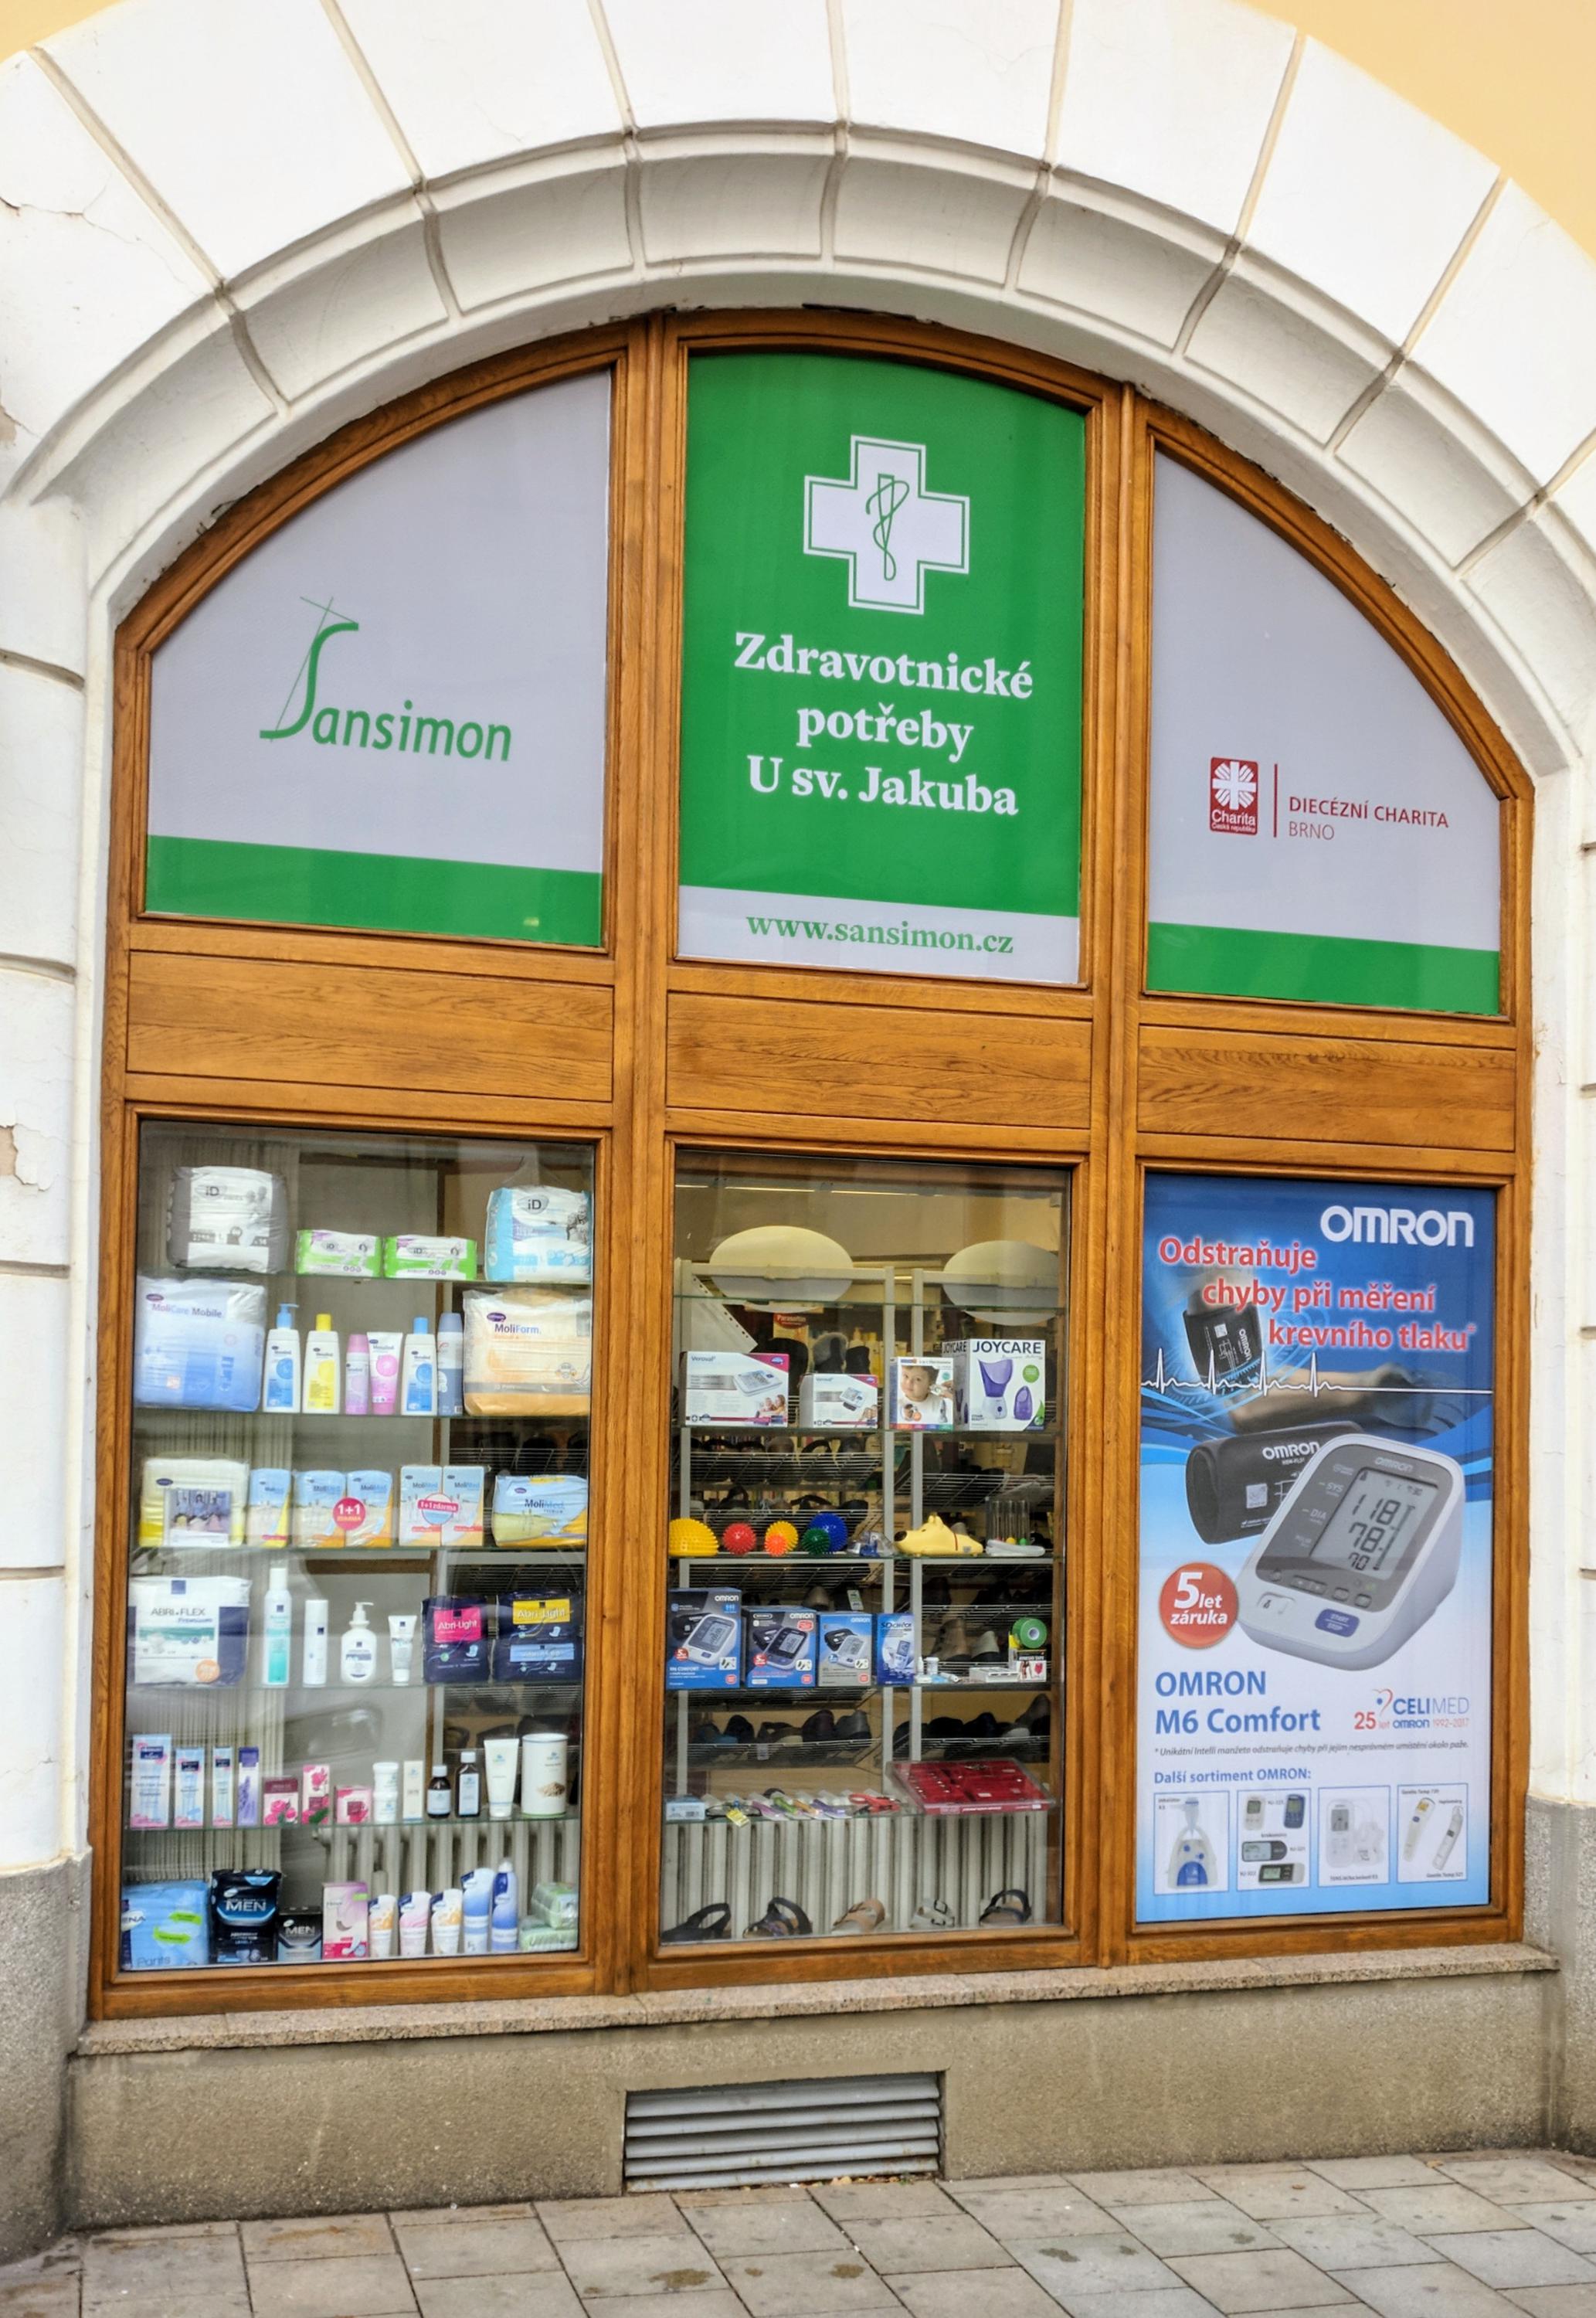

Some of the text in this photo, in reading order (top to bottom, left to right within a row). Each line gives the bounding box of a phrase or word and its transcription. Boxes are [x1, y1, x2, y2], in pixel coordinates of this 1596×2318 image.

[735, 631, 1033, 699] Zdravotnické
[260, 621, 511, 761] Sansimon
[796, 702, 974, 763] potřeby
[746, 754, 1019, 816] U sv. Jakuba
[1211, 809, 1256, 826] Charita
[1289, 796, 1449, 828] DIECÉZNÍ CHARITA
[1289, 821, 1335, 840] BRNO
[745, 916, 1014, 954] www.sansimon.cz
[528, 1199, 542, 1210] iD
[1320, 1205, 1475, 1247] OMRON
[1160, 1237, 1317, 1274] Odstraňuje
[1203, 1277, 1438, 1314] chyby při měření
[1268, 1319, 1391, 1349] krevního
[973, 1341, 1042, 1354] JOYCARE
[1262, 1441, 1320, 1460] OMRON
[338, 1504, 361, 1514] 1+1
[1310, 1509, 1327, 1520] DIA
[1173, 1571, 1222, 1609] 5 let
[1170, 1607, 1228, 1626] záruka
[1156, 1671, 1267, 1697] OMRON
[1392, 1698, 1470, 1715] CELIMED
[1156, 1705, 1321, 1735] M6 Comfort
[1354, 1711, 1377, 1730] 25
[1154, 1768, 1312, 1784] Další sortiment OMRON:
[226, 1900, 267, 1912] MEN
[285, 1925, 315, 1936] MEN
